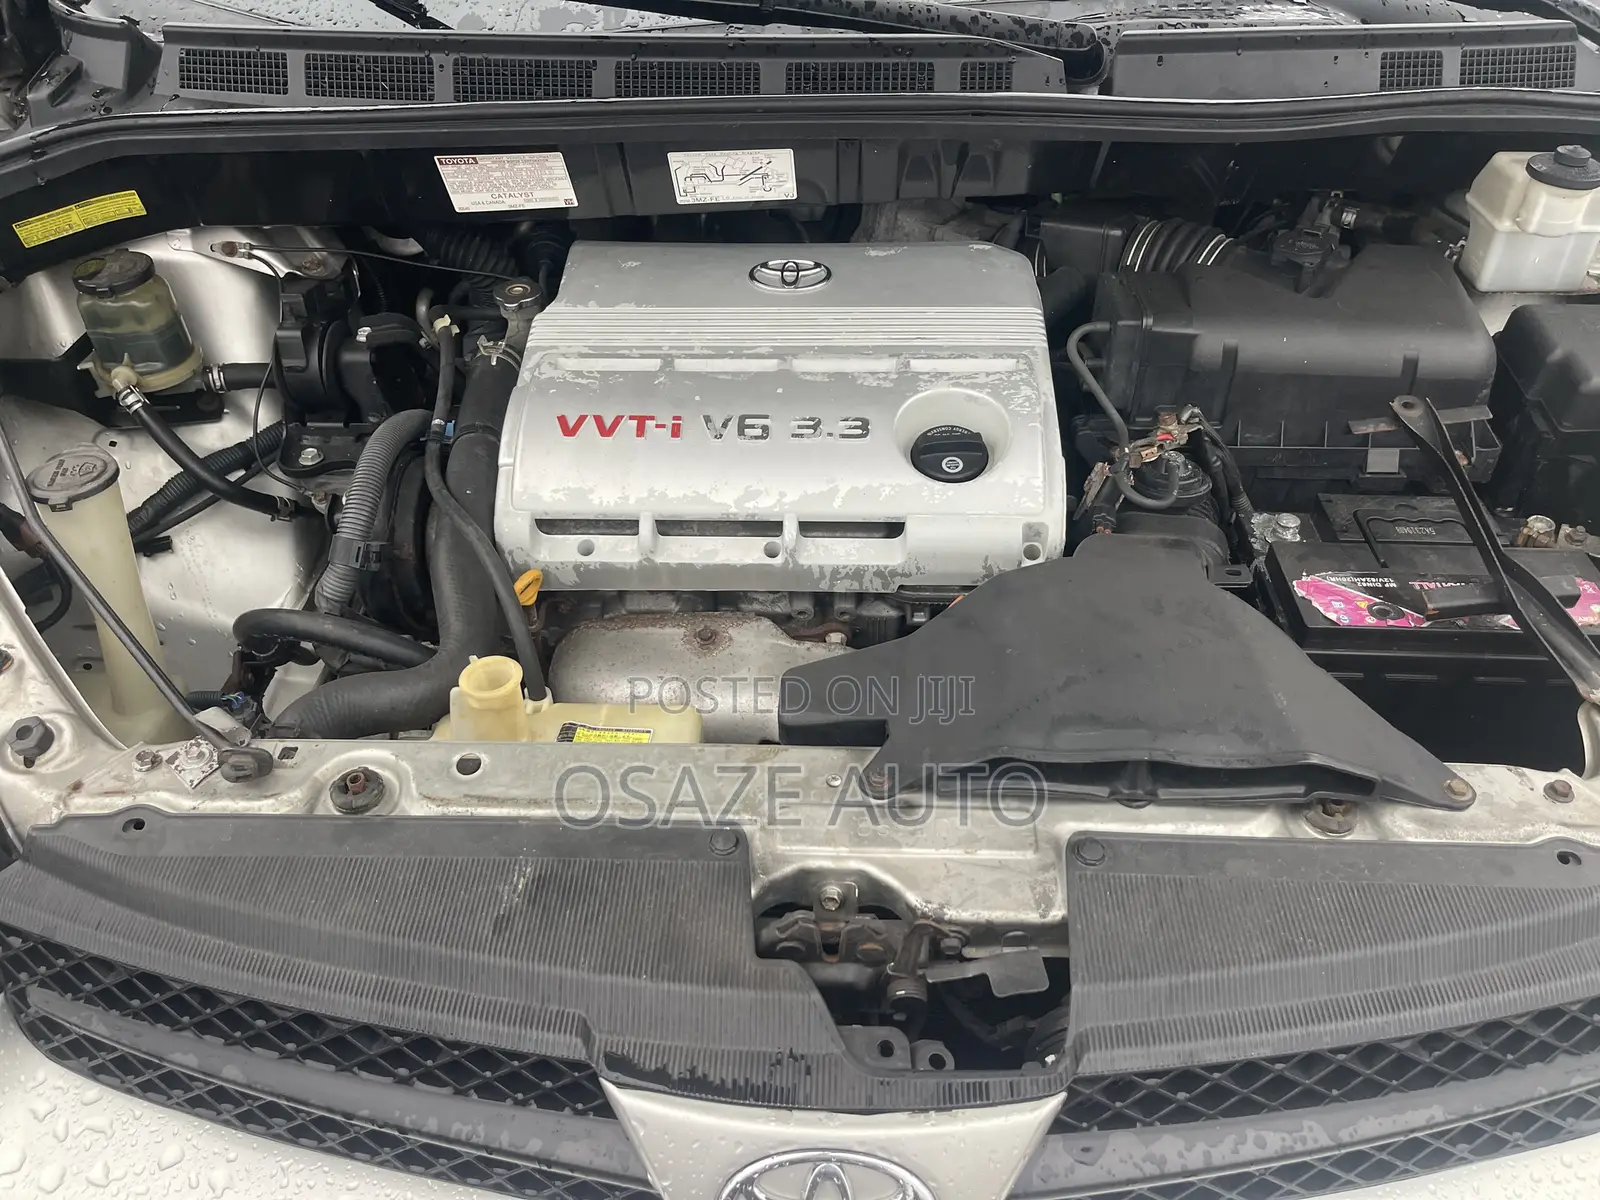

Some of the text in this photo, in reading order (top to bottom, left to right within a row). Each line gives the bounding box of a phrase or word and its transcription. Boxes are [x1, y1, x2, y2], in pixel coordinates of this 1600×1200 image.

[440, 157, 476, 165] TOYOTA
[491, 191, 535, 200] CATALYST
[556, 414, 871, 442] VVT-i V6 3.3
